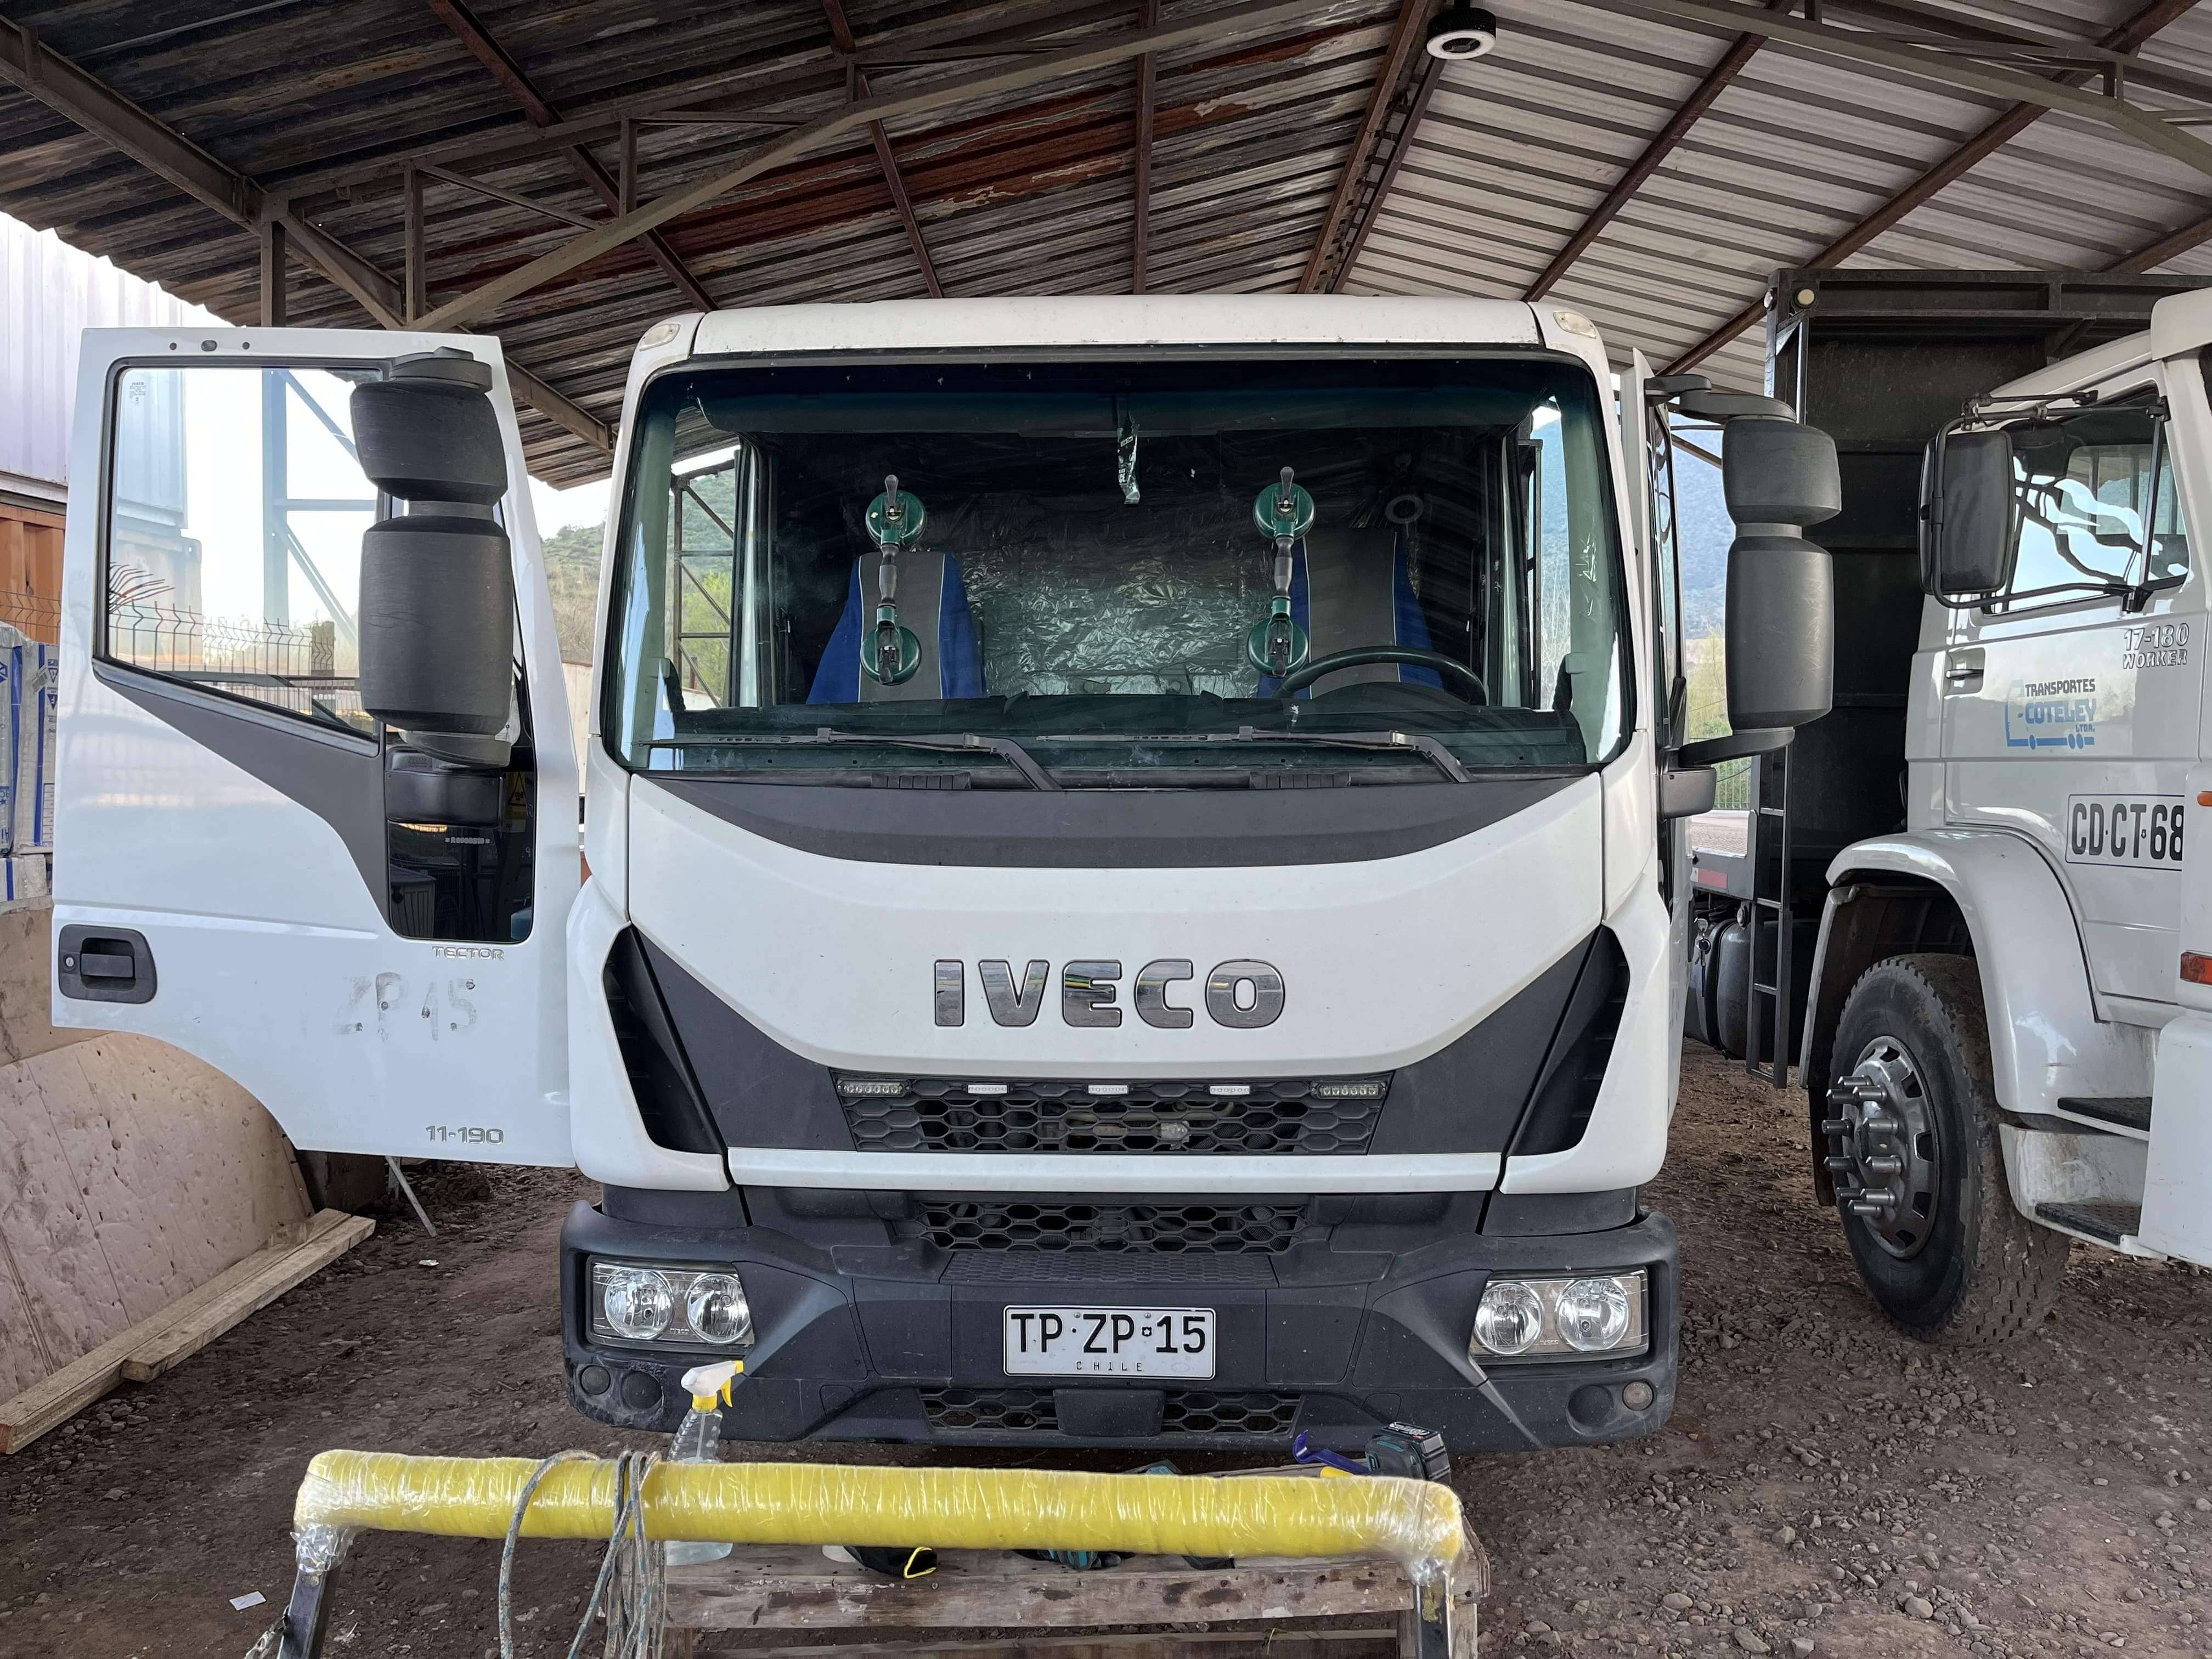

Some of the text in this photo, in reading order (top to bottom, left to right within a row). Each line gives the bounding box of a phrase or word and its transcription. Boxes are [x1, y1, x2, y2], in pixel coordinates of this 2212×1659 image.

[2124, 623, 2190, 651] 17-180
[2123, 649, 2188, 669] WORKER
[2025, 679, 2096, 697] TRANSPORTES
[2075, 724, 2095, 732] LTDA.
[432, 946, 505, 961] TECTOR
[934, 958, 1286, 1029] IVECO
[425, 1125, 505, 1145] 11-190
[1076, 1361, 1143, 1372] CHILE
